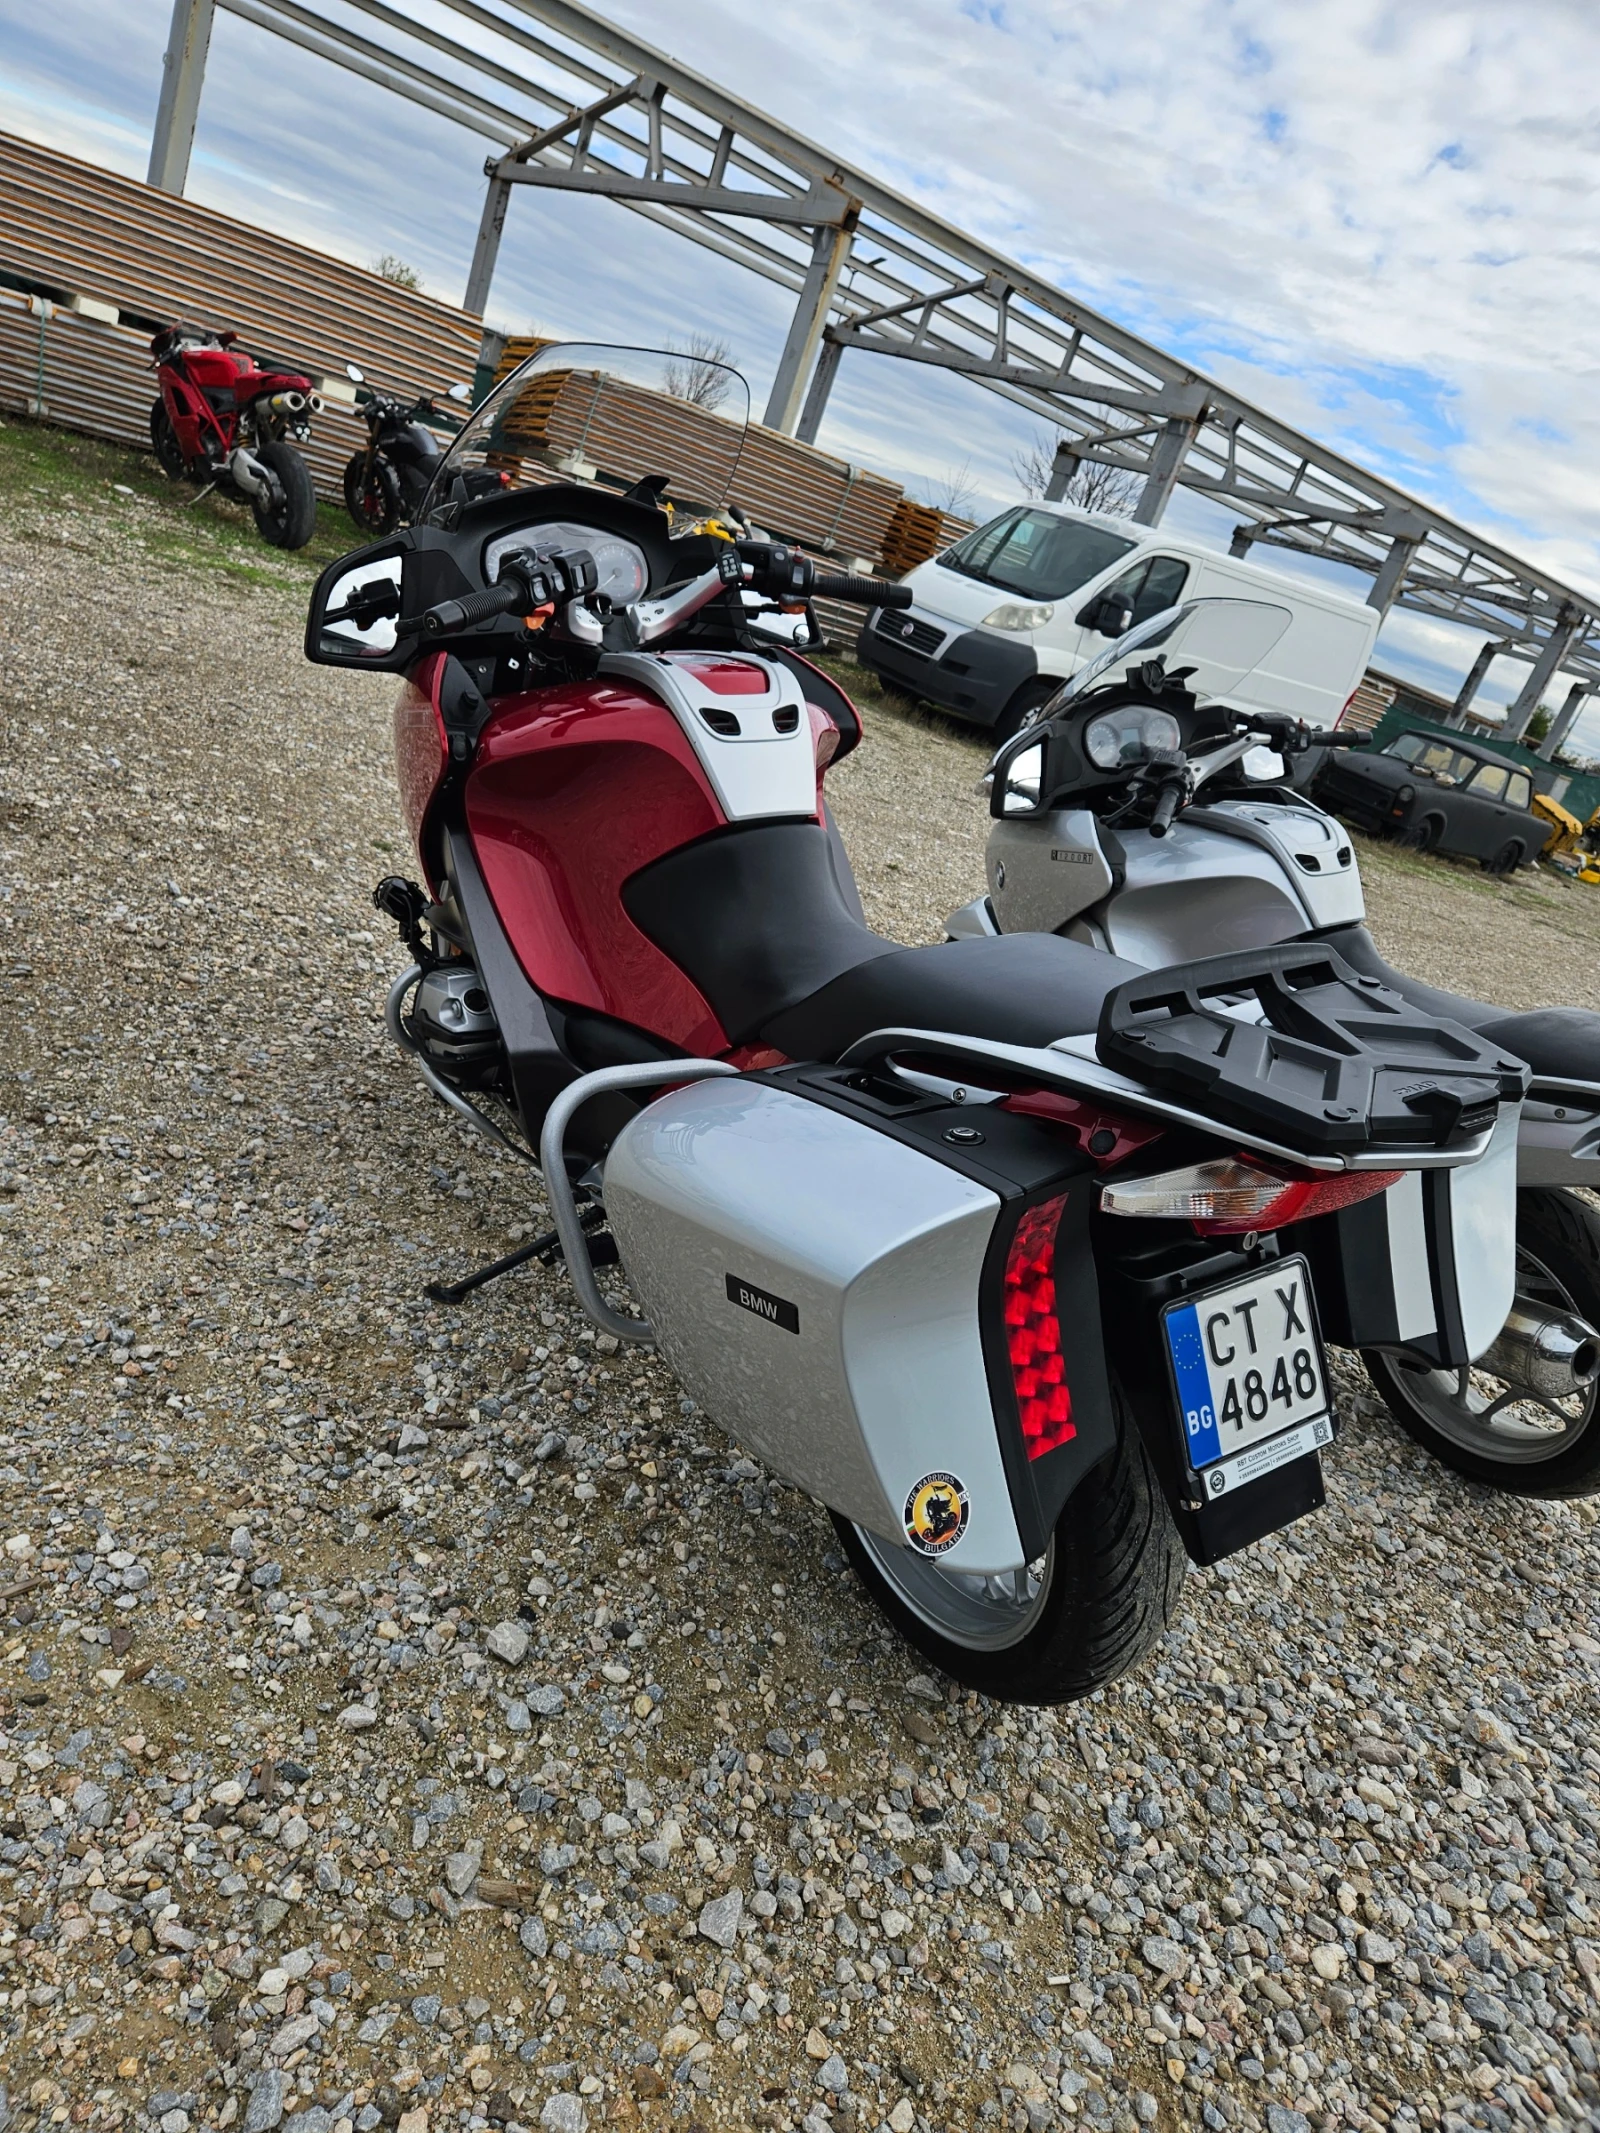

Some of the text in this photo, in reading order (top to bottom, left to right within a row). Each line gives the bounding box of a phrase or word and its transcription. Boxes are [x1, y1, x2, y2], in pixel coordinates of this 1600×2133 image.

[740, 1288, 777, 1320] BMW
[1276, 1281, 1306, 1341] X
[1221, 1348, 1318, 1432] 4848
[1187, 1404, 1213, 1436] BG
[906, 1473, 955, 1509] THE WARRIORS
[924, 1524, 967, 1552] BULGARIA
